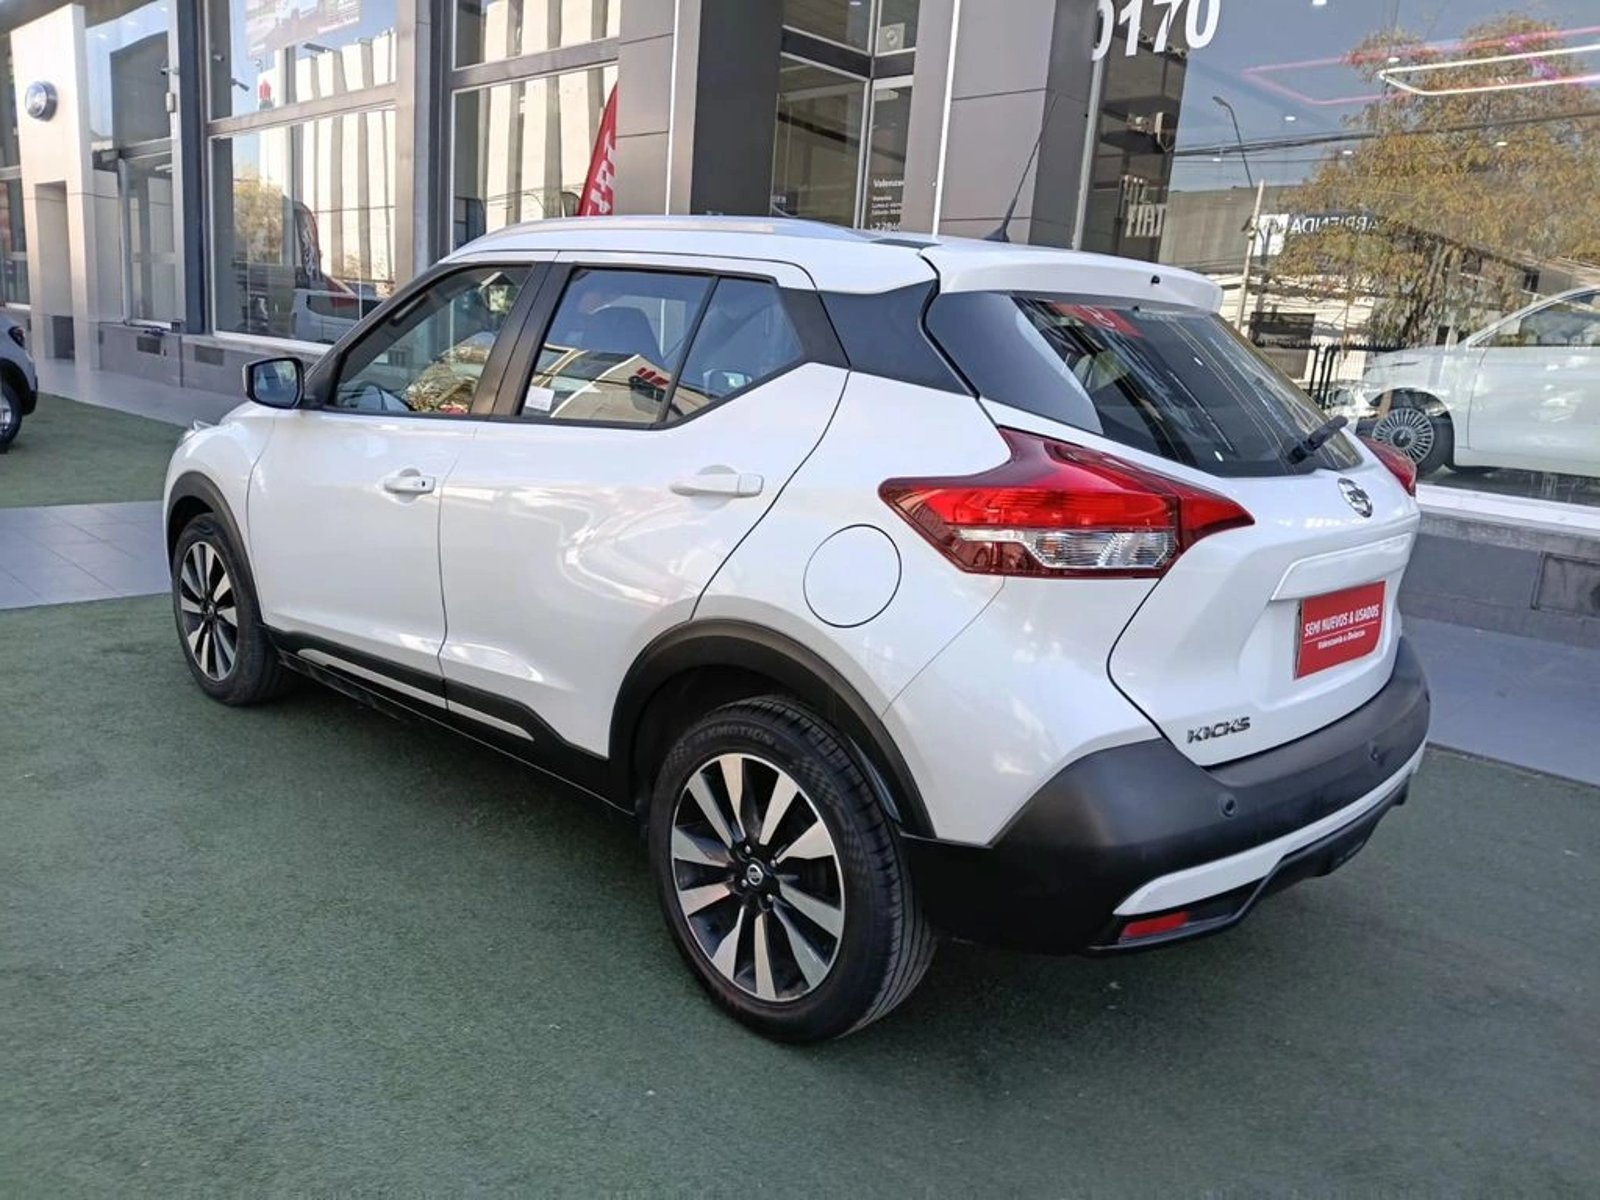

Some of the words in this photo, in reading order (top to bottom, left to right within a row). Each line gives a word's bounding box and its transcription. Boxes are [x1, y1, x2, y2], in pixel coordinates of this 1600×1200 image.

[586, 130, 617, 215] IAT
[1125, 204, 1166, 237] FIAT
[1304, 620, 1321, 637] SEMI
[1322, 612, 1348, 632] NUEVOS
[1355, 603, 1380, 622] USADOS
[1187, 716, 1250, 743] KICKS
